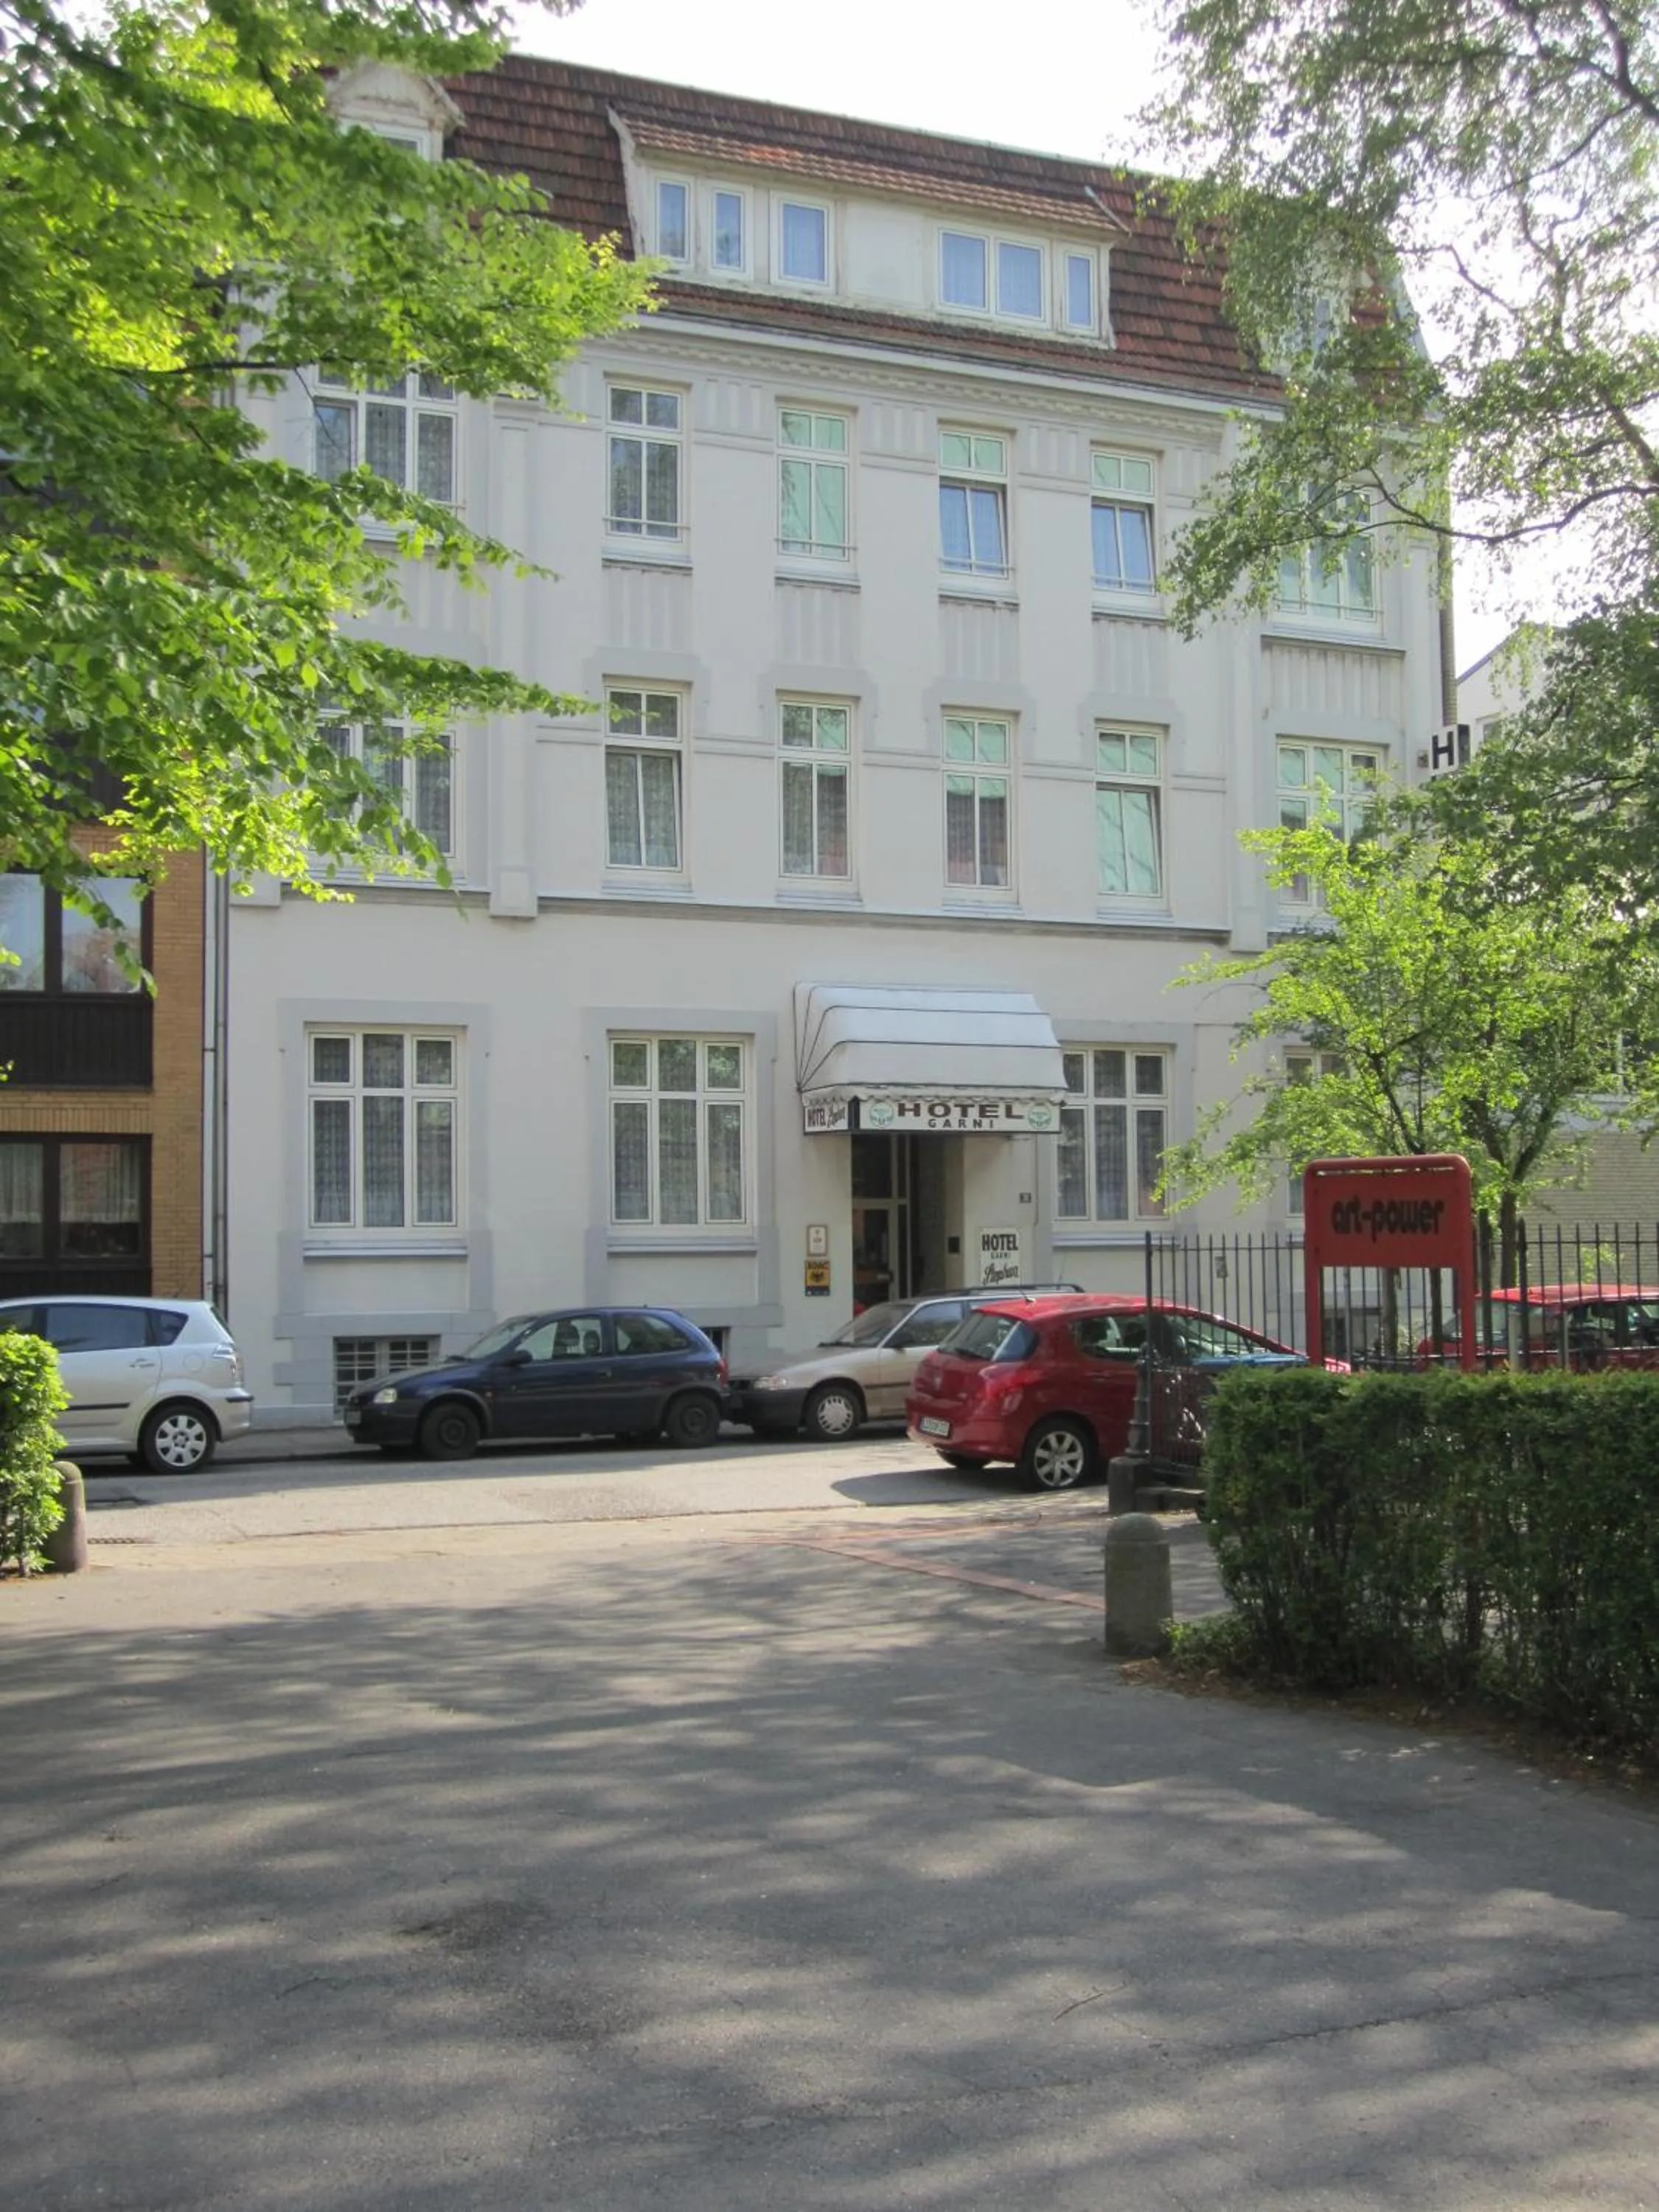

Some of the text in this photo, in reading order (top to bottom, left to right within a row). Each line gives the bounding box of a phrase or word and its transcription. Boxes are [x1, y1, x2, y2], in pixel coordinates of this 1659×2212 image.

[1432, 731, 1455, 770] H
[807, 1108, 827, 1127] HOTEL
[897, 1102, 1024, 1119] HOTEL
[928, 1119, 995, 1129] GARNI
[1331, 1194, 1445, 1244] art-power
[981, 1234, 1019, 1251] HOTEL
